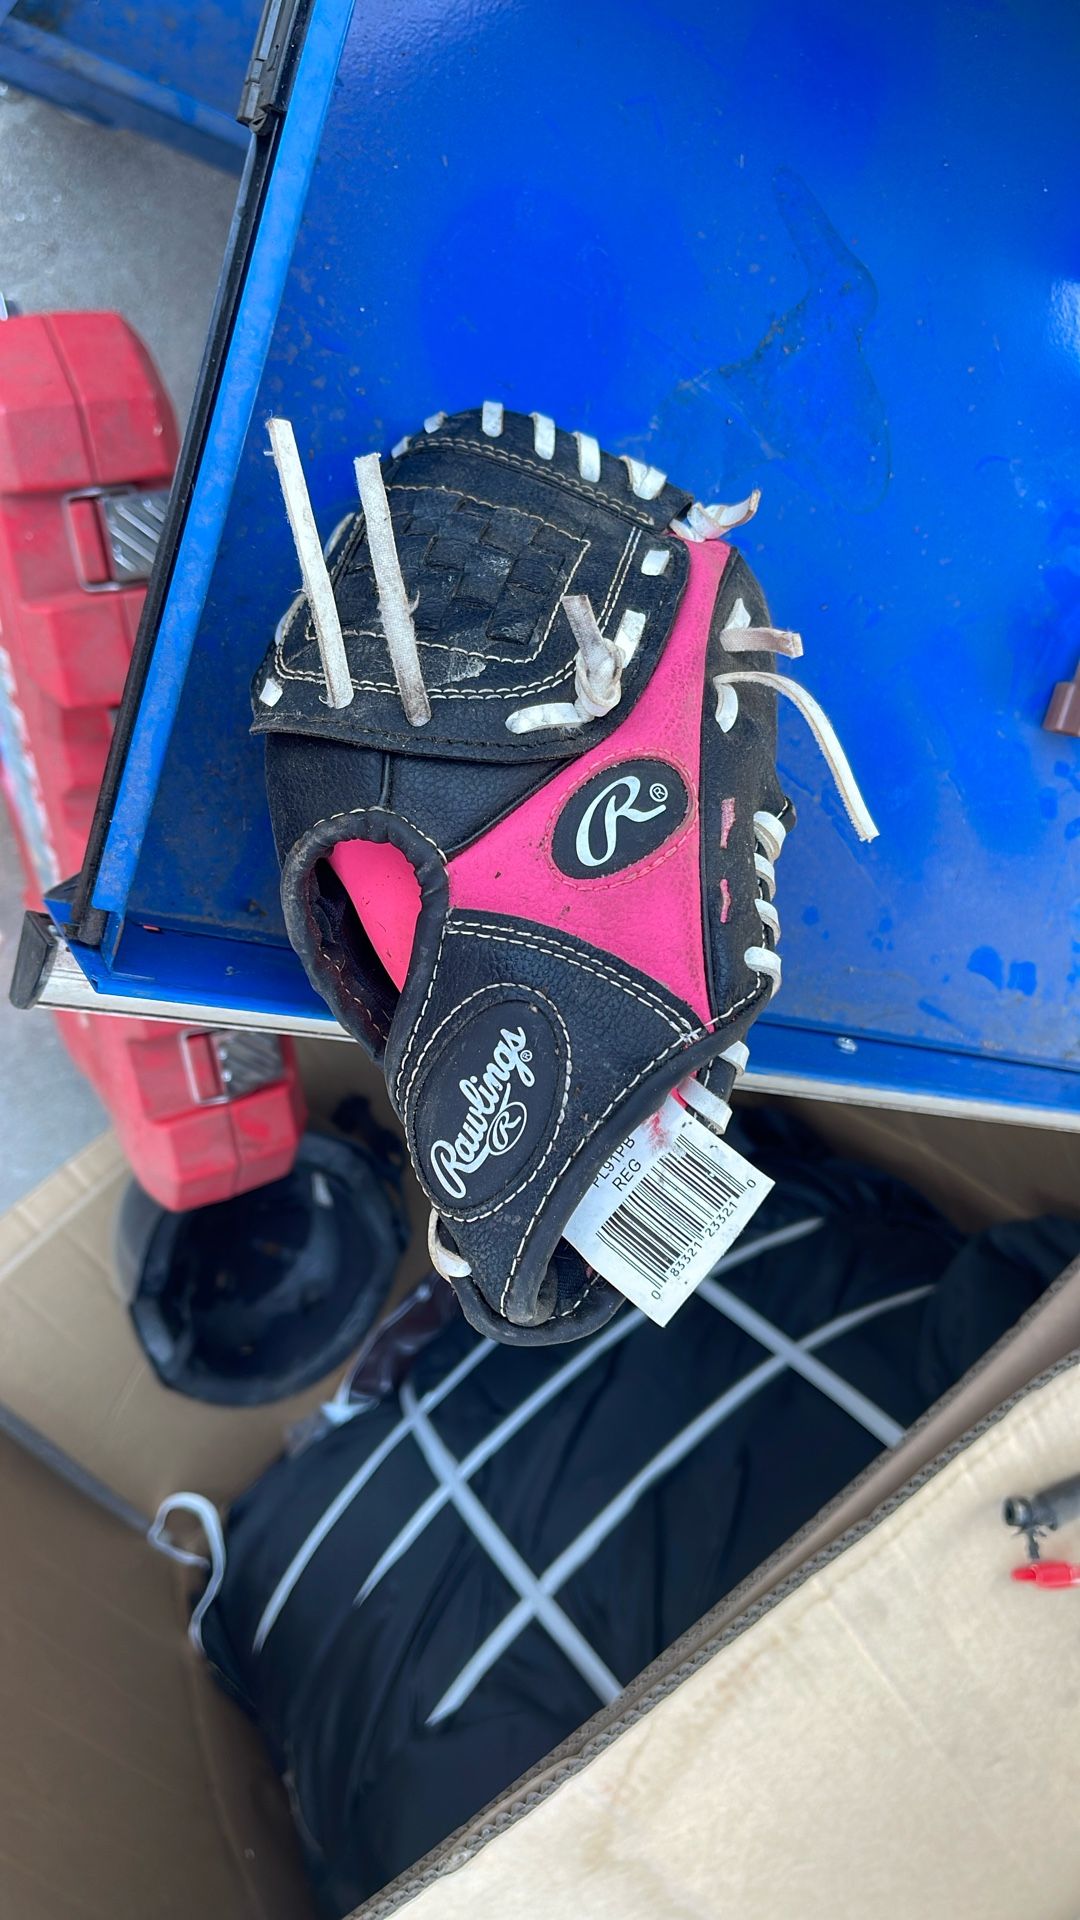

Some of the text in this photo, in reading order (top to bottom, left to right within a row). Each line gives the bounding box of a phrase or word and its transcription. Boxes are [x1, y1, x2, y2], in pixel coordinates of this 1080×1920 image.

[430, 1026, 535, 1199] Rawlings
[612, 1158, 642, 1192] REG
[669, 1241, 703, 1277] 83321
[705, 1202, 738, 1237] 23321
